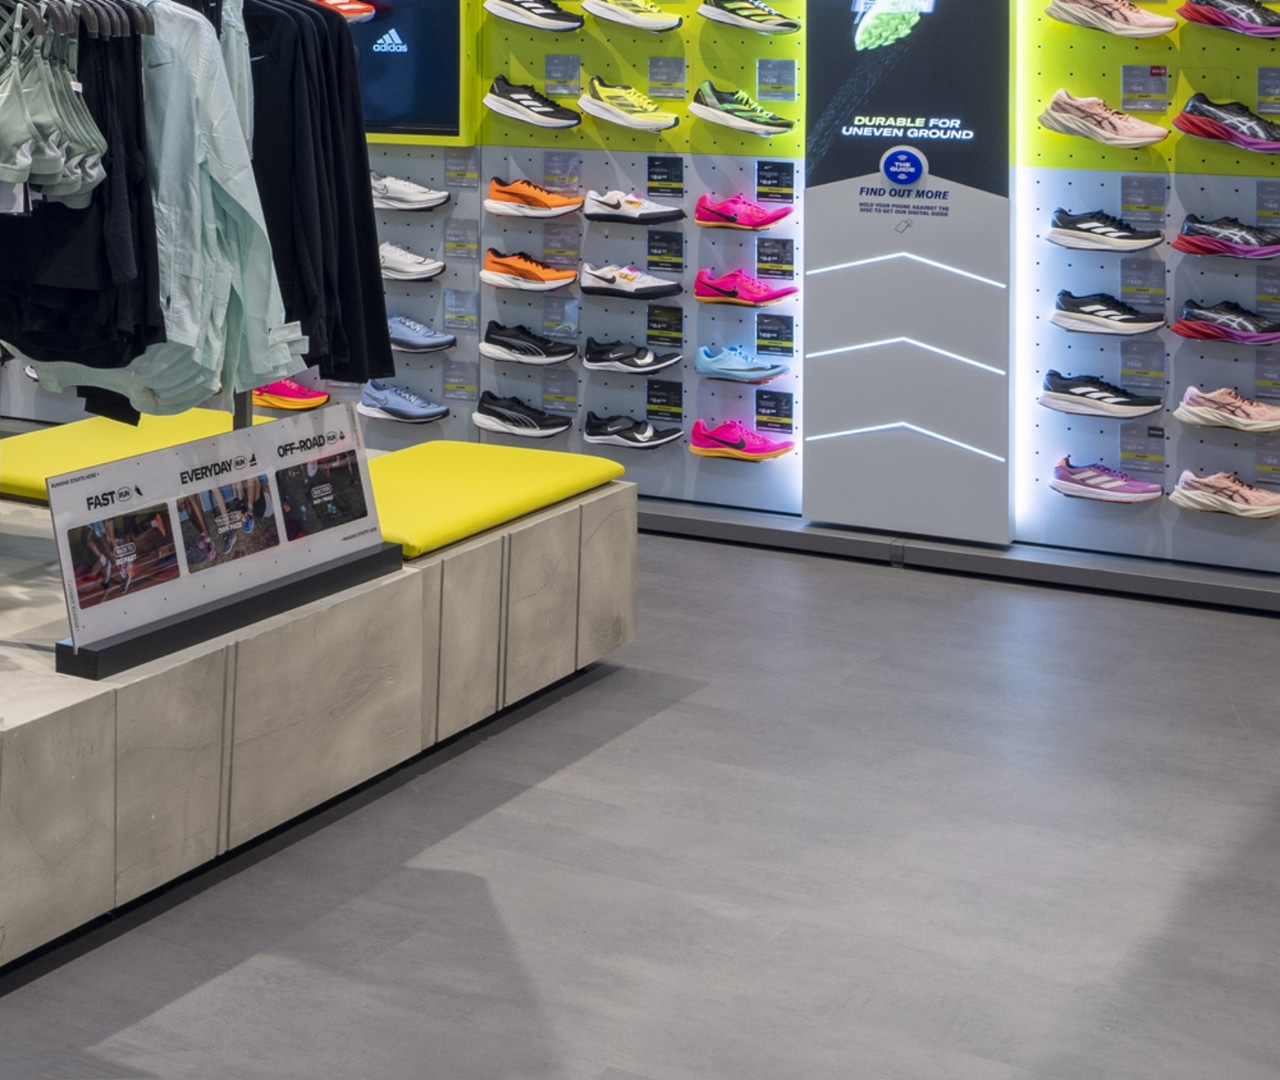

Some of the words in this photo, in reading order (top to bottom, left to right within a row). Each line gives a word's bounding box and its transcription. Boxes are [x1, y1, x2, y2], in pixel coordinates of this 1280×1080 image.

[372, 42, 408, 53] adidas
[853, 116, 926, 128] DURABLE
[928, 118, 961, 129] FOR
[841, 126, 904, 138] UNEVEN
[906, 128, 974, 140] GROUND
[859, 187, 886, 197] FIND
[889, 188, 912, 198] OUT
[915, 189, 949, 200] MORE
[277, 434, 325, 458] OFF-ROAD
[235, 458, 245, 466] RUN
[180, 459, 233, 485] EVERYDAY
[50, 479, 70, 488] RUNNING
[70, 476, 85, 484] STARTS
[85, 472, 97, 480] HERE
[86, 490, 116, 511] FAST
[118, 490, 130, 498] RUN
